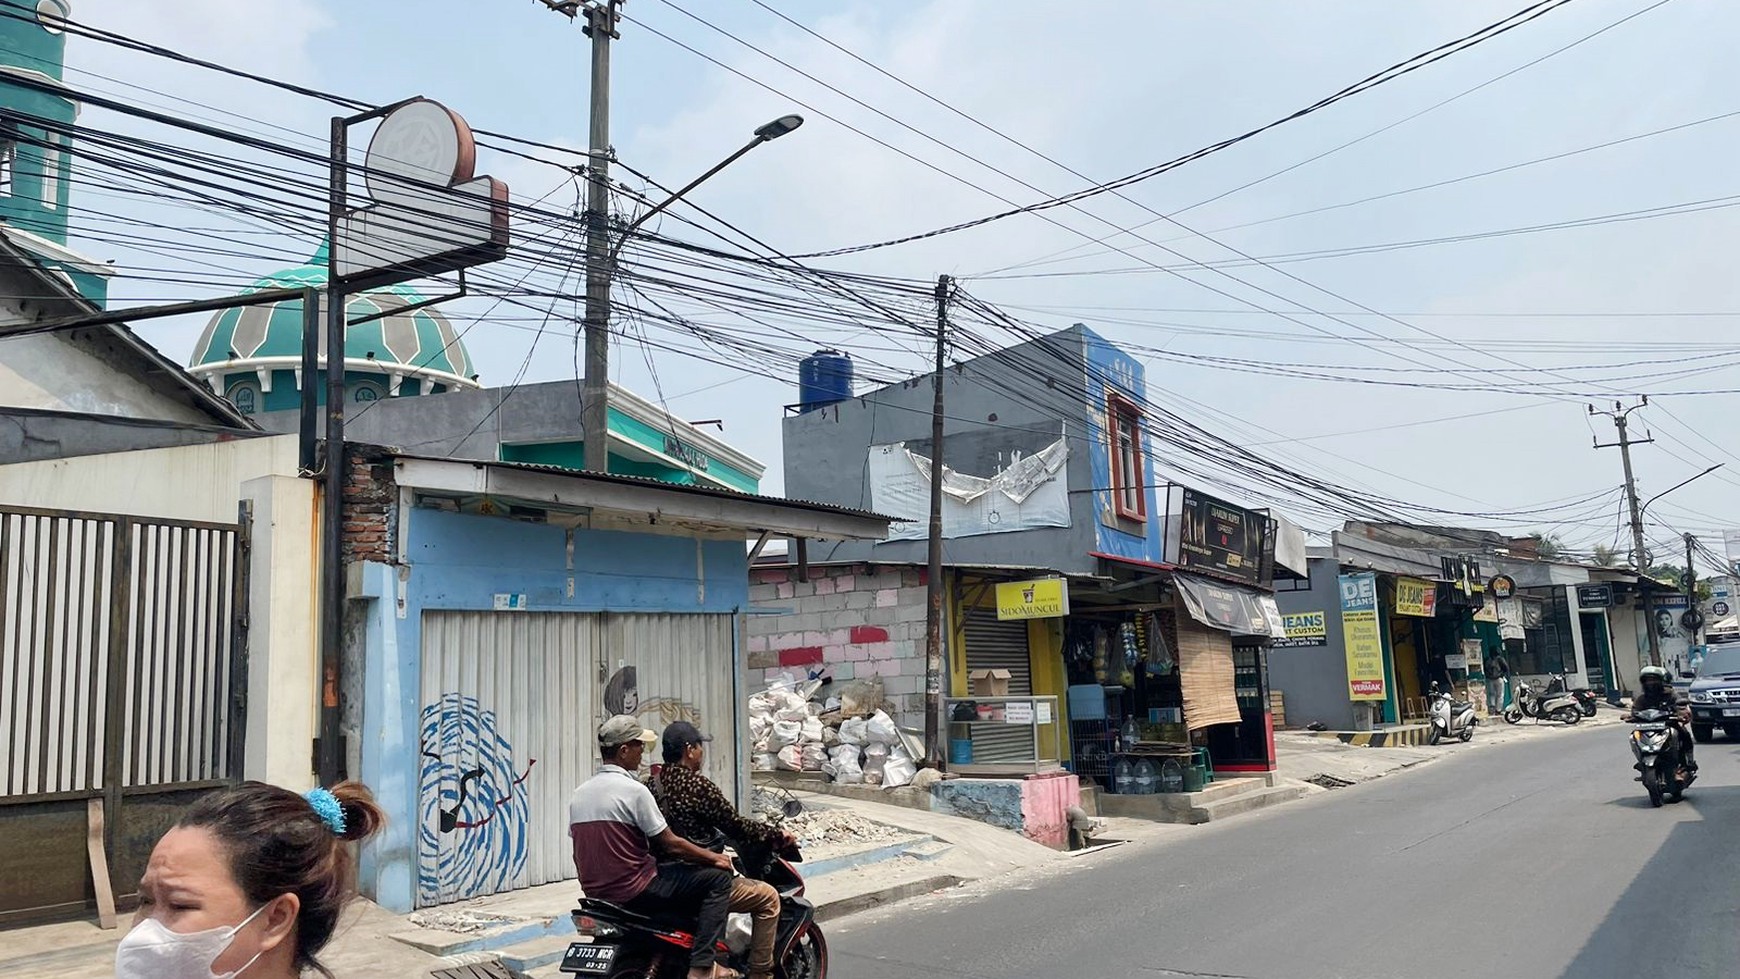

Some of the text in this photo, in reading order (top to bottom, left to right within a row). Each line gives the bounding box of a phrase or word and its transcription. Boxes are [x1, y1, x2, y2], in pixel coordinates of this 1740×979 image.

[1342, 580, 1373, 600] DE
[1346, 598, 1374, 608] JEANS
[1294, 627, 1323, 635] CUSTOM
[1352, 683, 1381, 692] VERMAK
[576, 947, 596, 958] 3733
